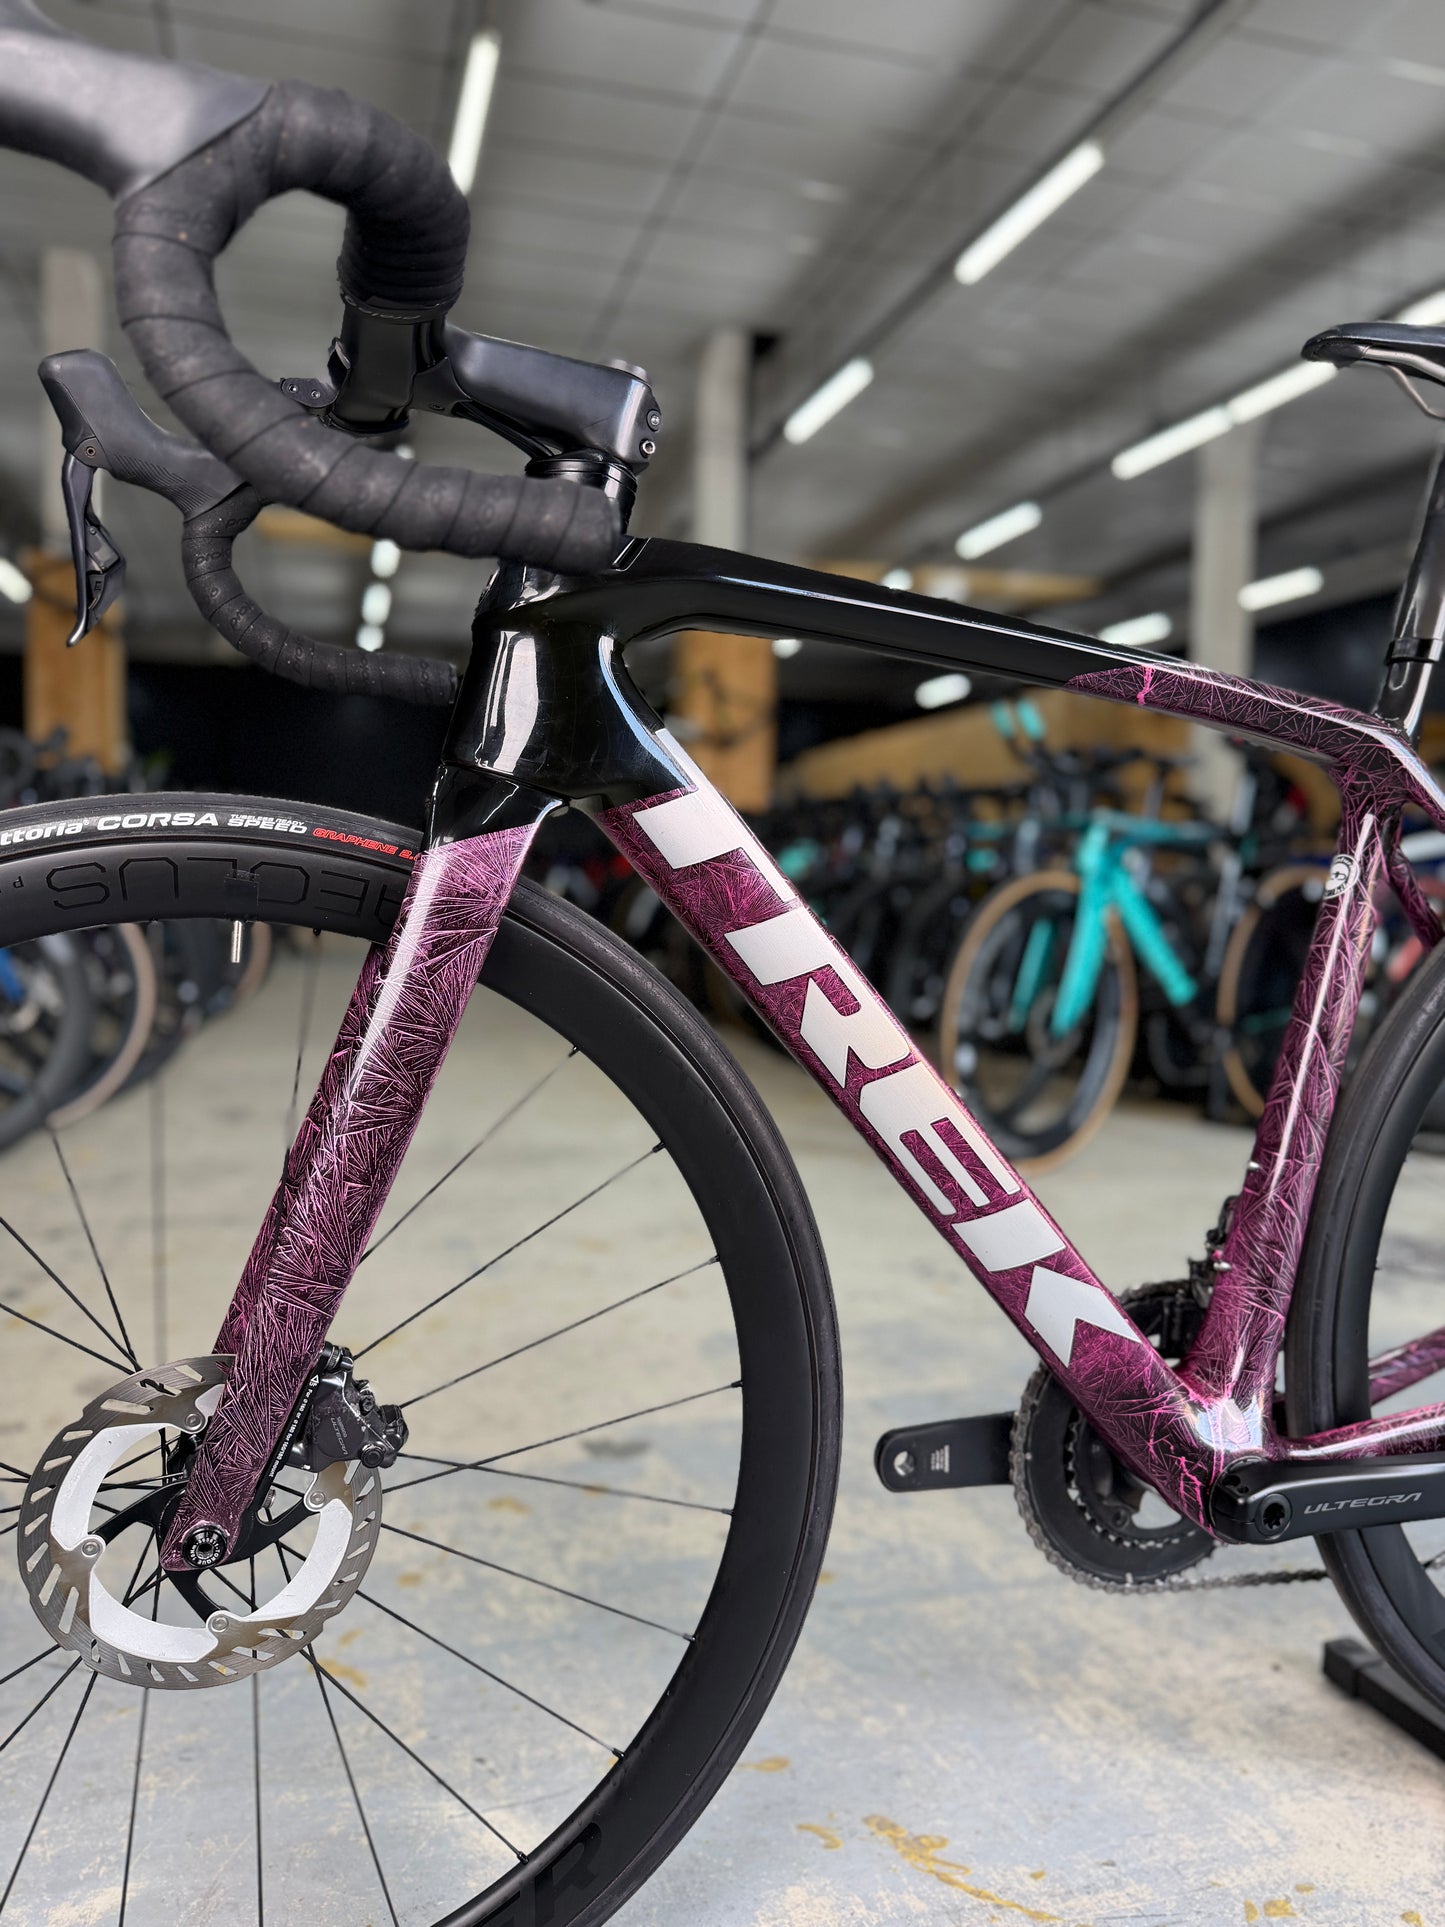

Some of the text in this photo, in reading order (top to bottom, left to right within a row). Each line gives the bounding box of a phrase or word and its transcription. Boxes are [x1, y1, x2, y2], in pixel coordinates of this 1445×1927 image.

[97, 813, 219, 831] CORSA
[227, 818, 308, 834] SPEED
[231, 814, 304, 826] TUBELESS READY
[312, 828, 398, 855] GRAPHENE
[632, 728, 1142, 1368] TREK
[1303, 1492, 1422, 1515] ULTEGRA
